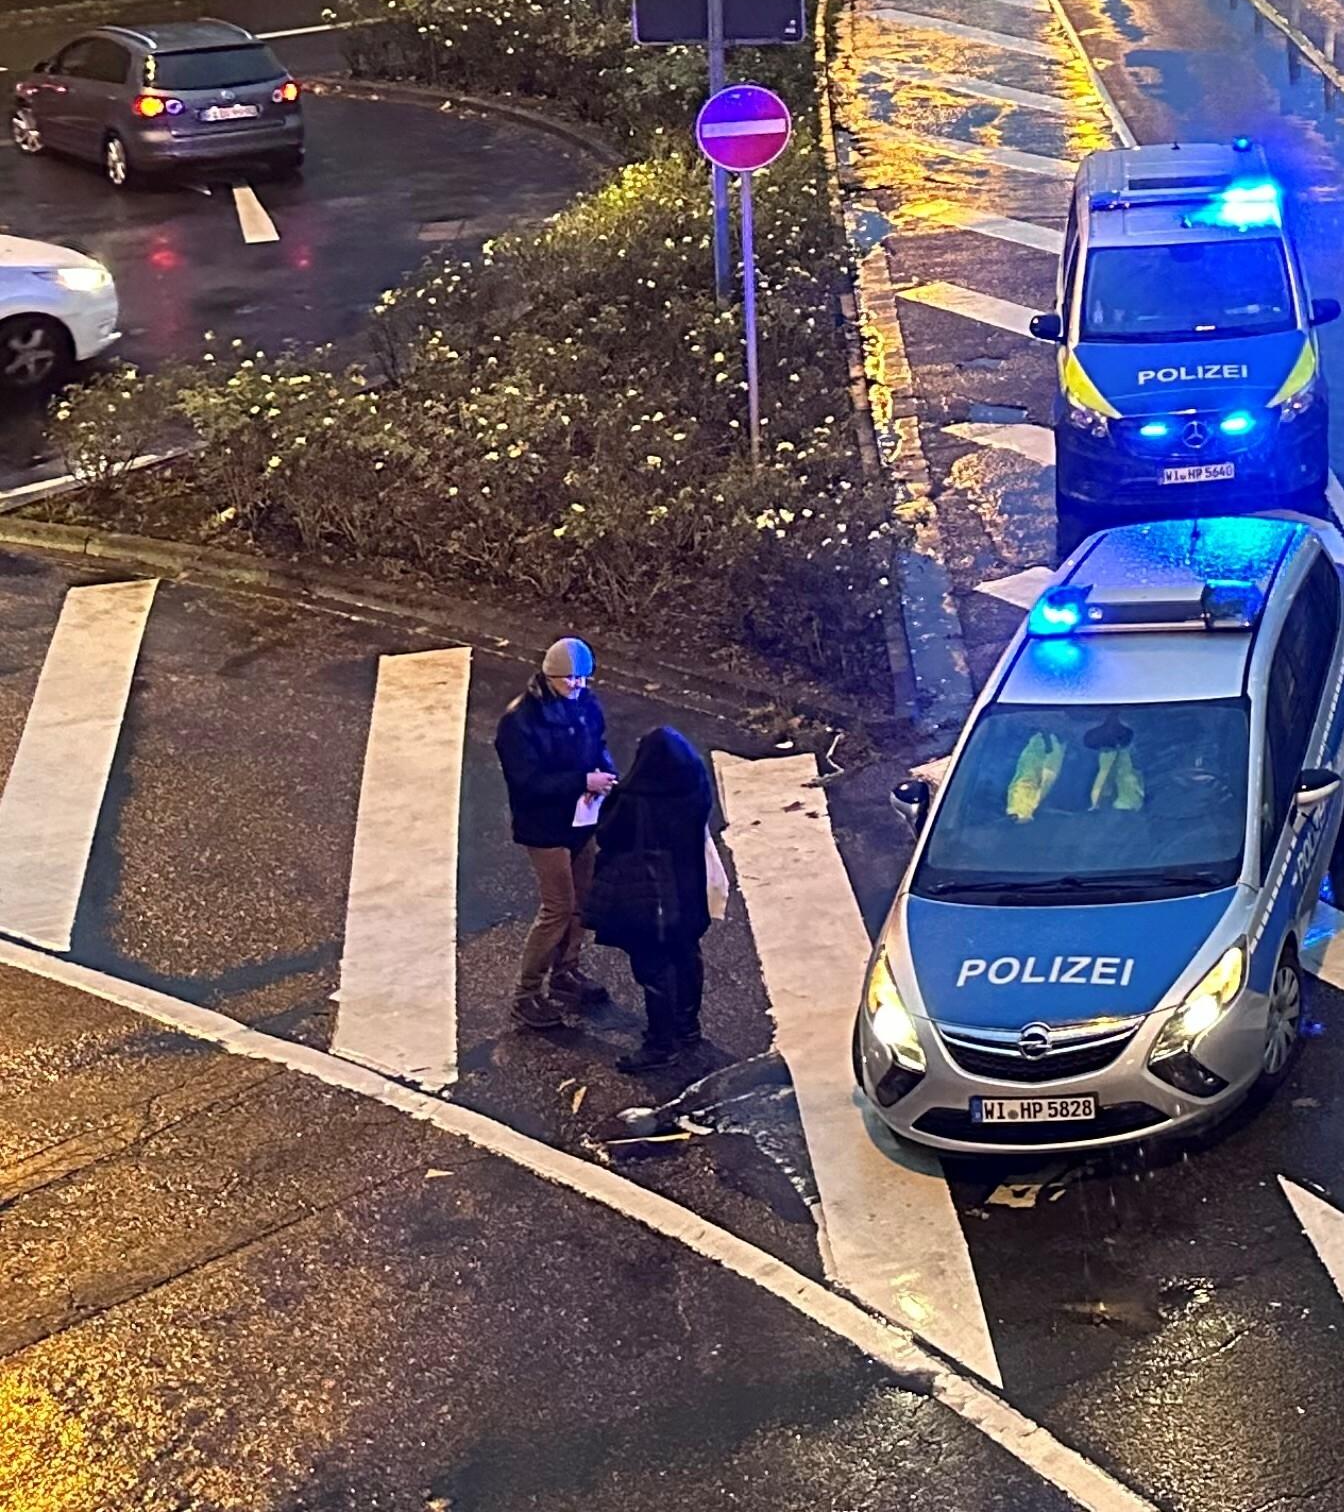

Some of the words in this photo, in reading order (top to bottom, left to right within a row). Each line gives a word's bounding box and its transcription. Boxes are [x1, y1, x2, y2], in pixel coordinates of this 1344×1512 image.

[1138, 364, 1248, 385] POLIZEI
[956, 955, 1135, 988] POLIZEI
[1049, 1099, 1093, 1118] 5828
